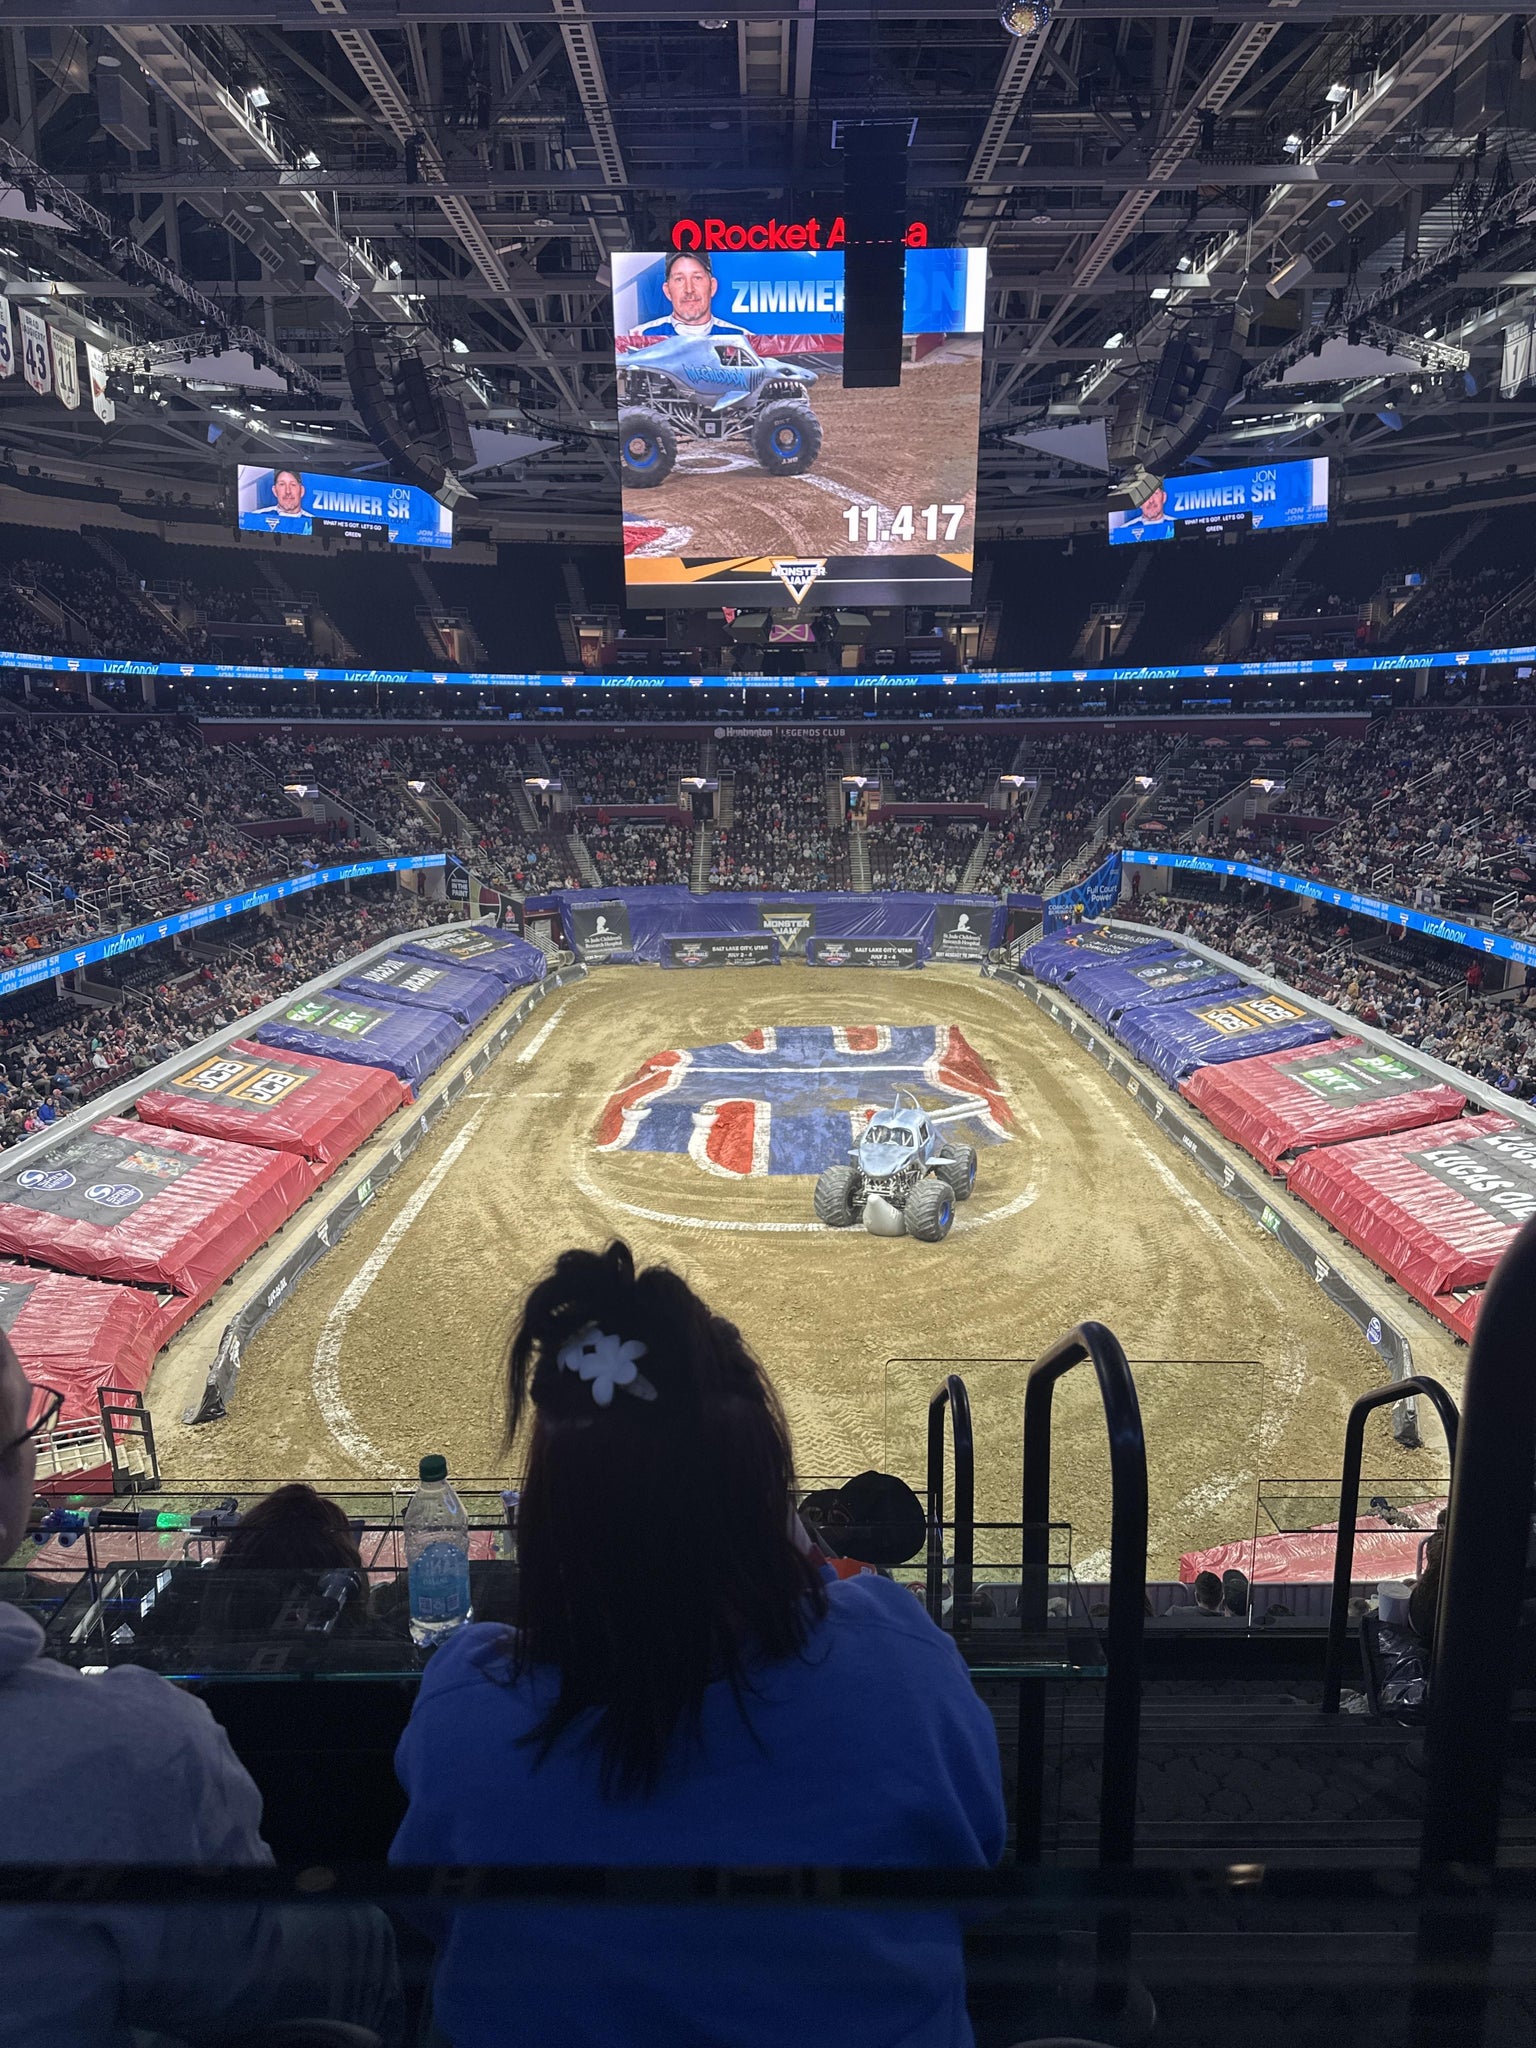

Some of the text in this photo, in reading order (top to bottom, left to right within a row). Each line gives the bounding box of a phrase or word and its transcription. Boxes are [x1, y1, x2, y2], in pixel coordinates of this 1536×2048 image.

[705, 218, 821, 250] Rocket
[26, 339, 47, 380] 43
[57, 357, 75, 394] 11
[683, 364, 748, 389] MEGALODON
[1252, 469, 1276, 484] JON
[388, 488, 410, 500] JON
[1174, 482, 1276, 512] ZIMMER SR
[313, 490, 410, 519] ZIMMER SR
[771, 567, 826, 577] MONSTER
[781, 728, 821, 737] LEGENDS
[822, 728, 846, 736] CLUB
[452, 889, 468, 897] PAINT
[1087, 885, 1118, 894] Full Court
[1091, 894, 1112, 902] Power
[1511, 941, 1526, 953] JON
[0, 955, 60, 983] JON ZIMMER SR
[19, 971, 48, 988] ZIMMER
[50, 966, 60, 978] SR
[288, 1002, 324, 1021] BKT
[1250, 1000, 1296, 1020] JCB
[333, 1011, 366, 1030] BKT
[192, 1062, 244, 1089] JCB
[1313, 1068, 1362, 1091] BKT
[246, 1073, 296, 1102] JCB
[38, 1172, 64, 1187] SPIN
[47, 1174, 72, 1189] MASTER
[1421, 1150, 1536, 1219] LUCAS OIL
[106, 1186, 130, 1202] SPIN
[115, 1190, 137, 1205] MASTER
[358, 1179, 371, 1203] BKT
[1261, 1206, 1281, 1232] BKT
